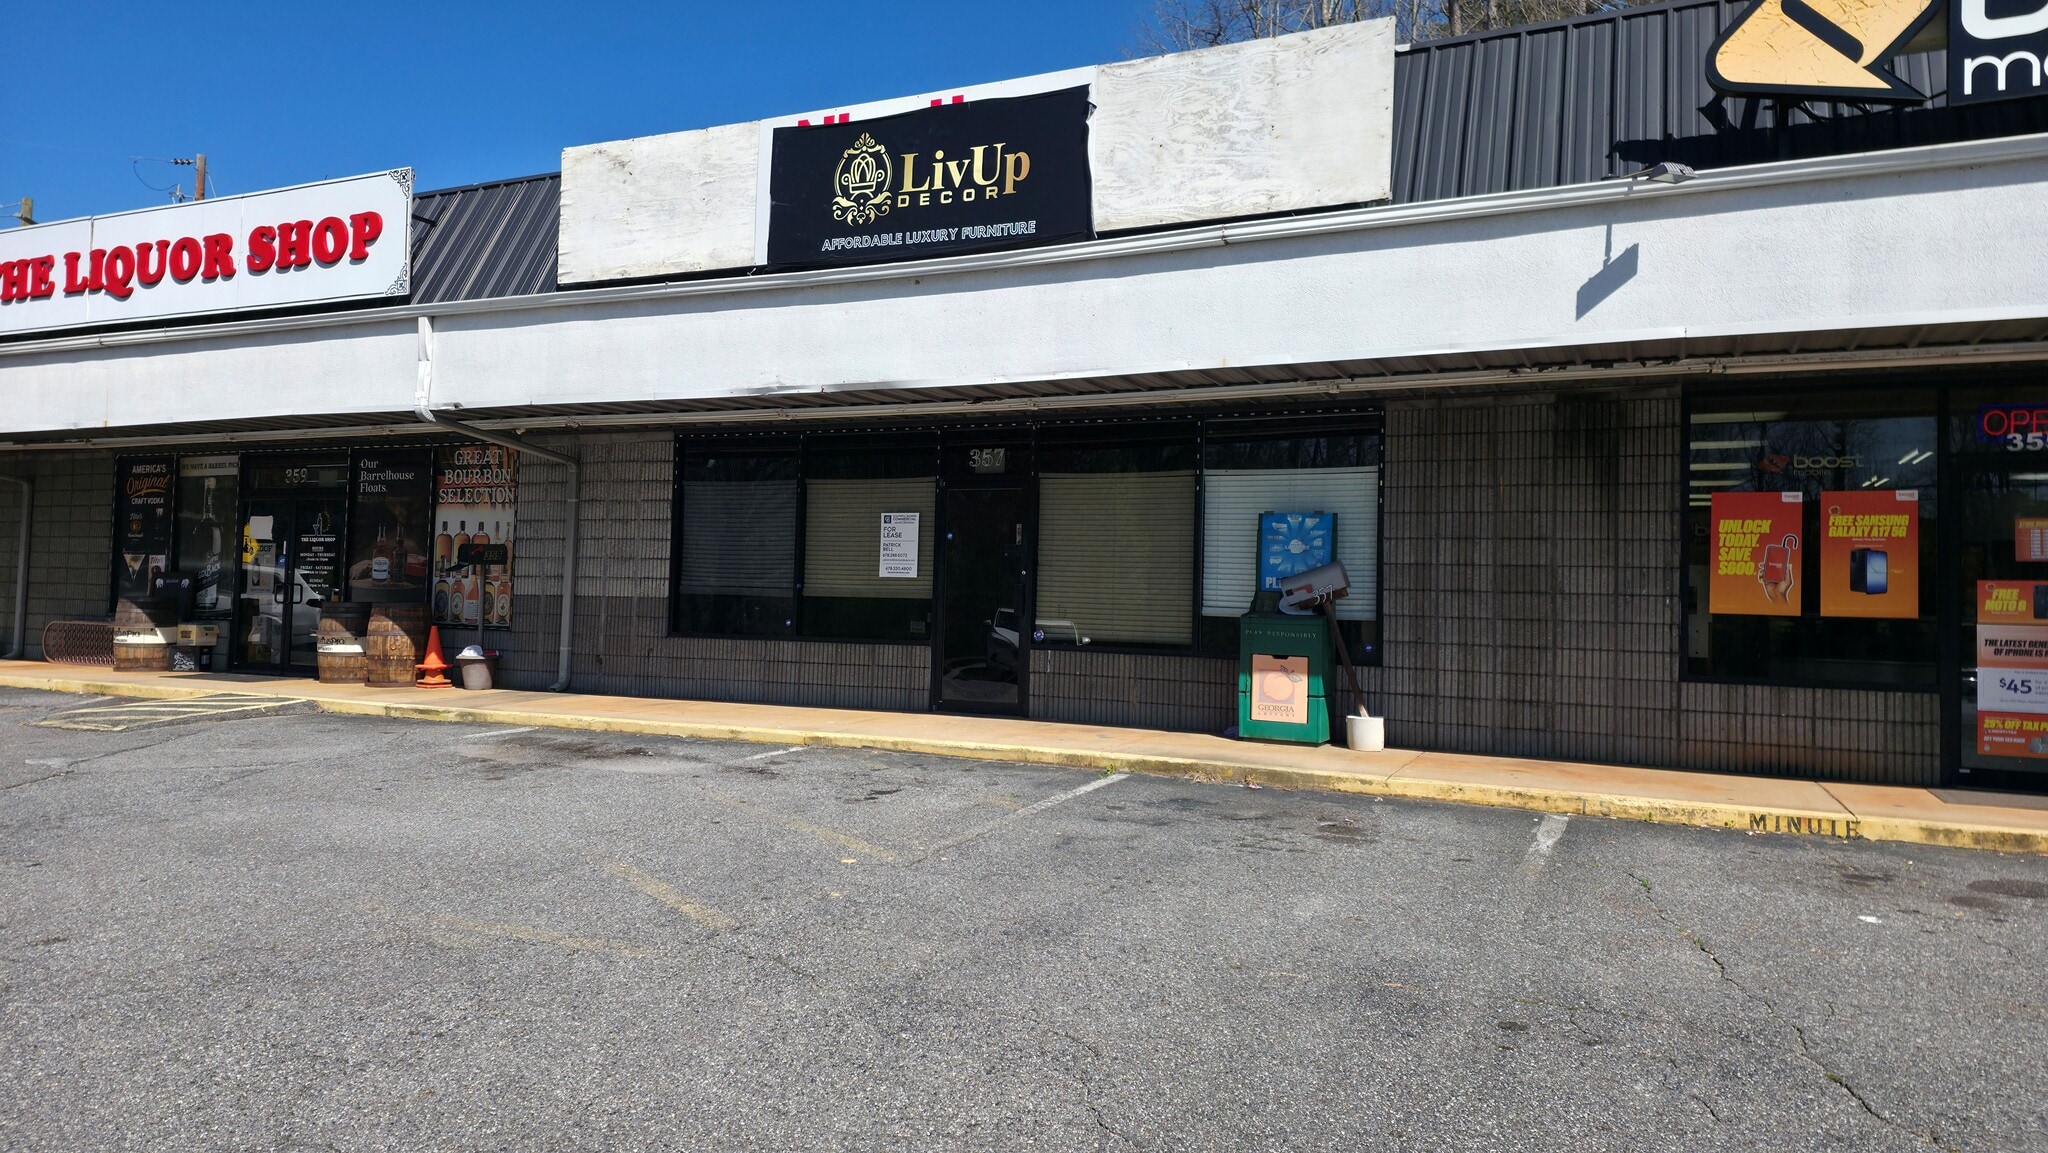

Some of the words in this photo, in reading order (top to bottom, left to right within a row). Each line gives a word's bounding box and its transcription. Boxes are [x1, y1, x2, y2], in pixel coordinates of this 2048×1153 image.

[1964, 51, 2048, 95] m
[899, 142, 1030, 194] LivUp
[897, 186, 998, 208] DECOR
[822, 232, 903, 251] AFFORDABLE
[905, 227, 959, 245] LUXURY
[961, 220, 1036, 240] FURNITURE
[0, 255, 55, 300] HE
[64, 233, 236, 297] LIQUOR
[247, 211, 383, 272] SHOP
[2006, 432, 2048, 452] 35
[360, 459, 379, 469] Our
[454, 450, 503, 466] GREAT
[969, 448, 1005, 468] 357
[1794, 453, 1864, 468] boost
[132, 464, 166, 474] AMERICA'S
[285, 468, 309, 483] 359
[361, 470, 414, 481] Barrelhouse
[444, 468, 513, 485] BOURBON
[127, 475, 170, 496] Original
[360, 483, 388, 493] Floats.
[438, 487, 517, 504] SELECTION
[1718, 519, 1772, 534] UNLOCK
[1829, 515, 1855, 526] FREE
[1855, 514, 1909, 526] SAMSUNG
[1829, 526, 1871, 538] GALAXY
[1871, 526, 1890, 538] A17
[1718, 533, 1760, 548] TODAY.
[484, 551, 502, 560] 359
[1718, 547, 1752, 562] SAVE
[1265, 577, 1282, 588] PL
[1312, 584, 1334, 606] 357
[1992, 588, 2019, 600] FREE
[1985, 600, 2018, 612] MOTO
[1985, 639, 1998, 647] THE
[2000, 639, 2028, 648] LATEST
[1994, 648, 2004, 656] OF
[2005, 648, 2034, 657] IPHONE
[2035, 649, 2044, 657] IS
[1999, 677, 2032, 694] $45
[1258, 704, 1294, 713] GEORGIA
[2004, 719, 2022, 730] OFF
[2023, 720, 2039, 731] TAX
[1750, 813, 1861, 840] MINUTE
